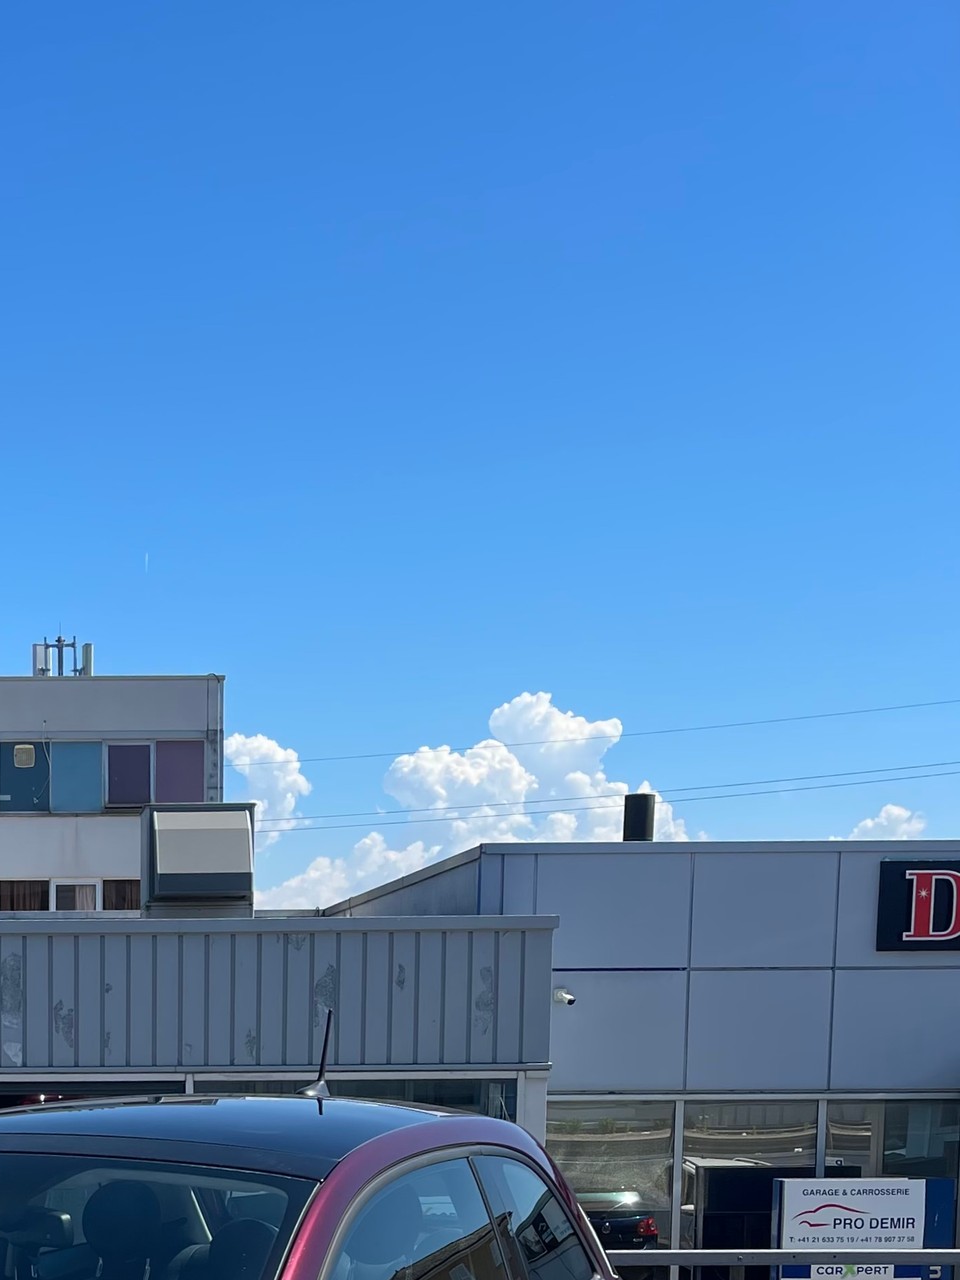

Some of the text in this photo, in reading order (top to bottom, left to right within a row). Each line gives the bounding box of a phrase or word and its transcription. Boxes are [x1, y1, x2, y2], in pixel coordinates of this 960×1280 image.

[802, 1188, 840, 1196] GARAGE
[833, 1217, 916, 1230] PRO DEMIR
